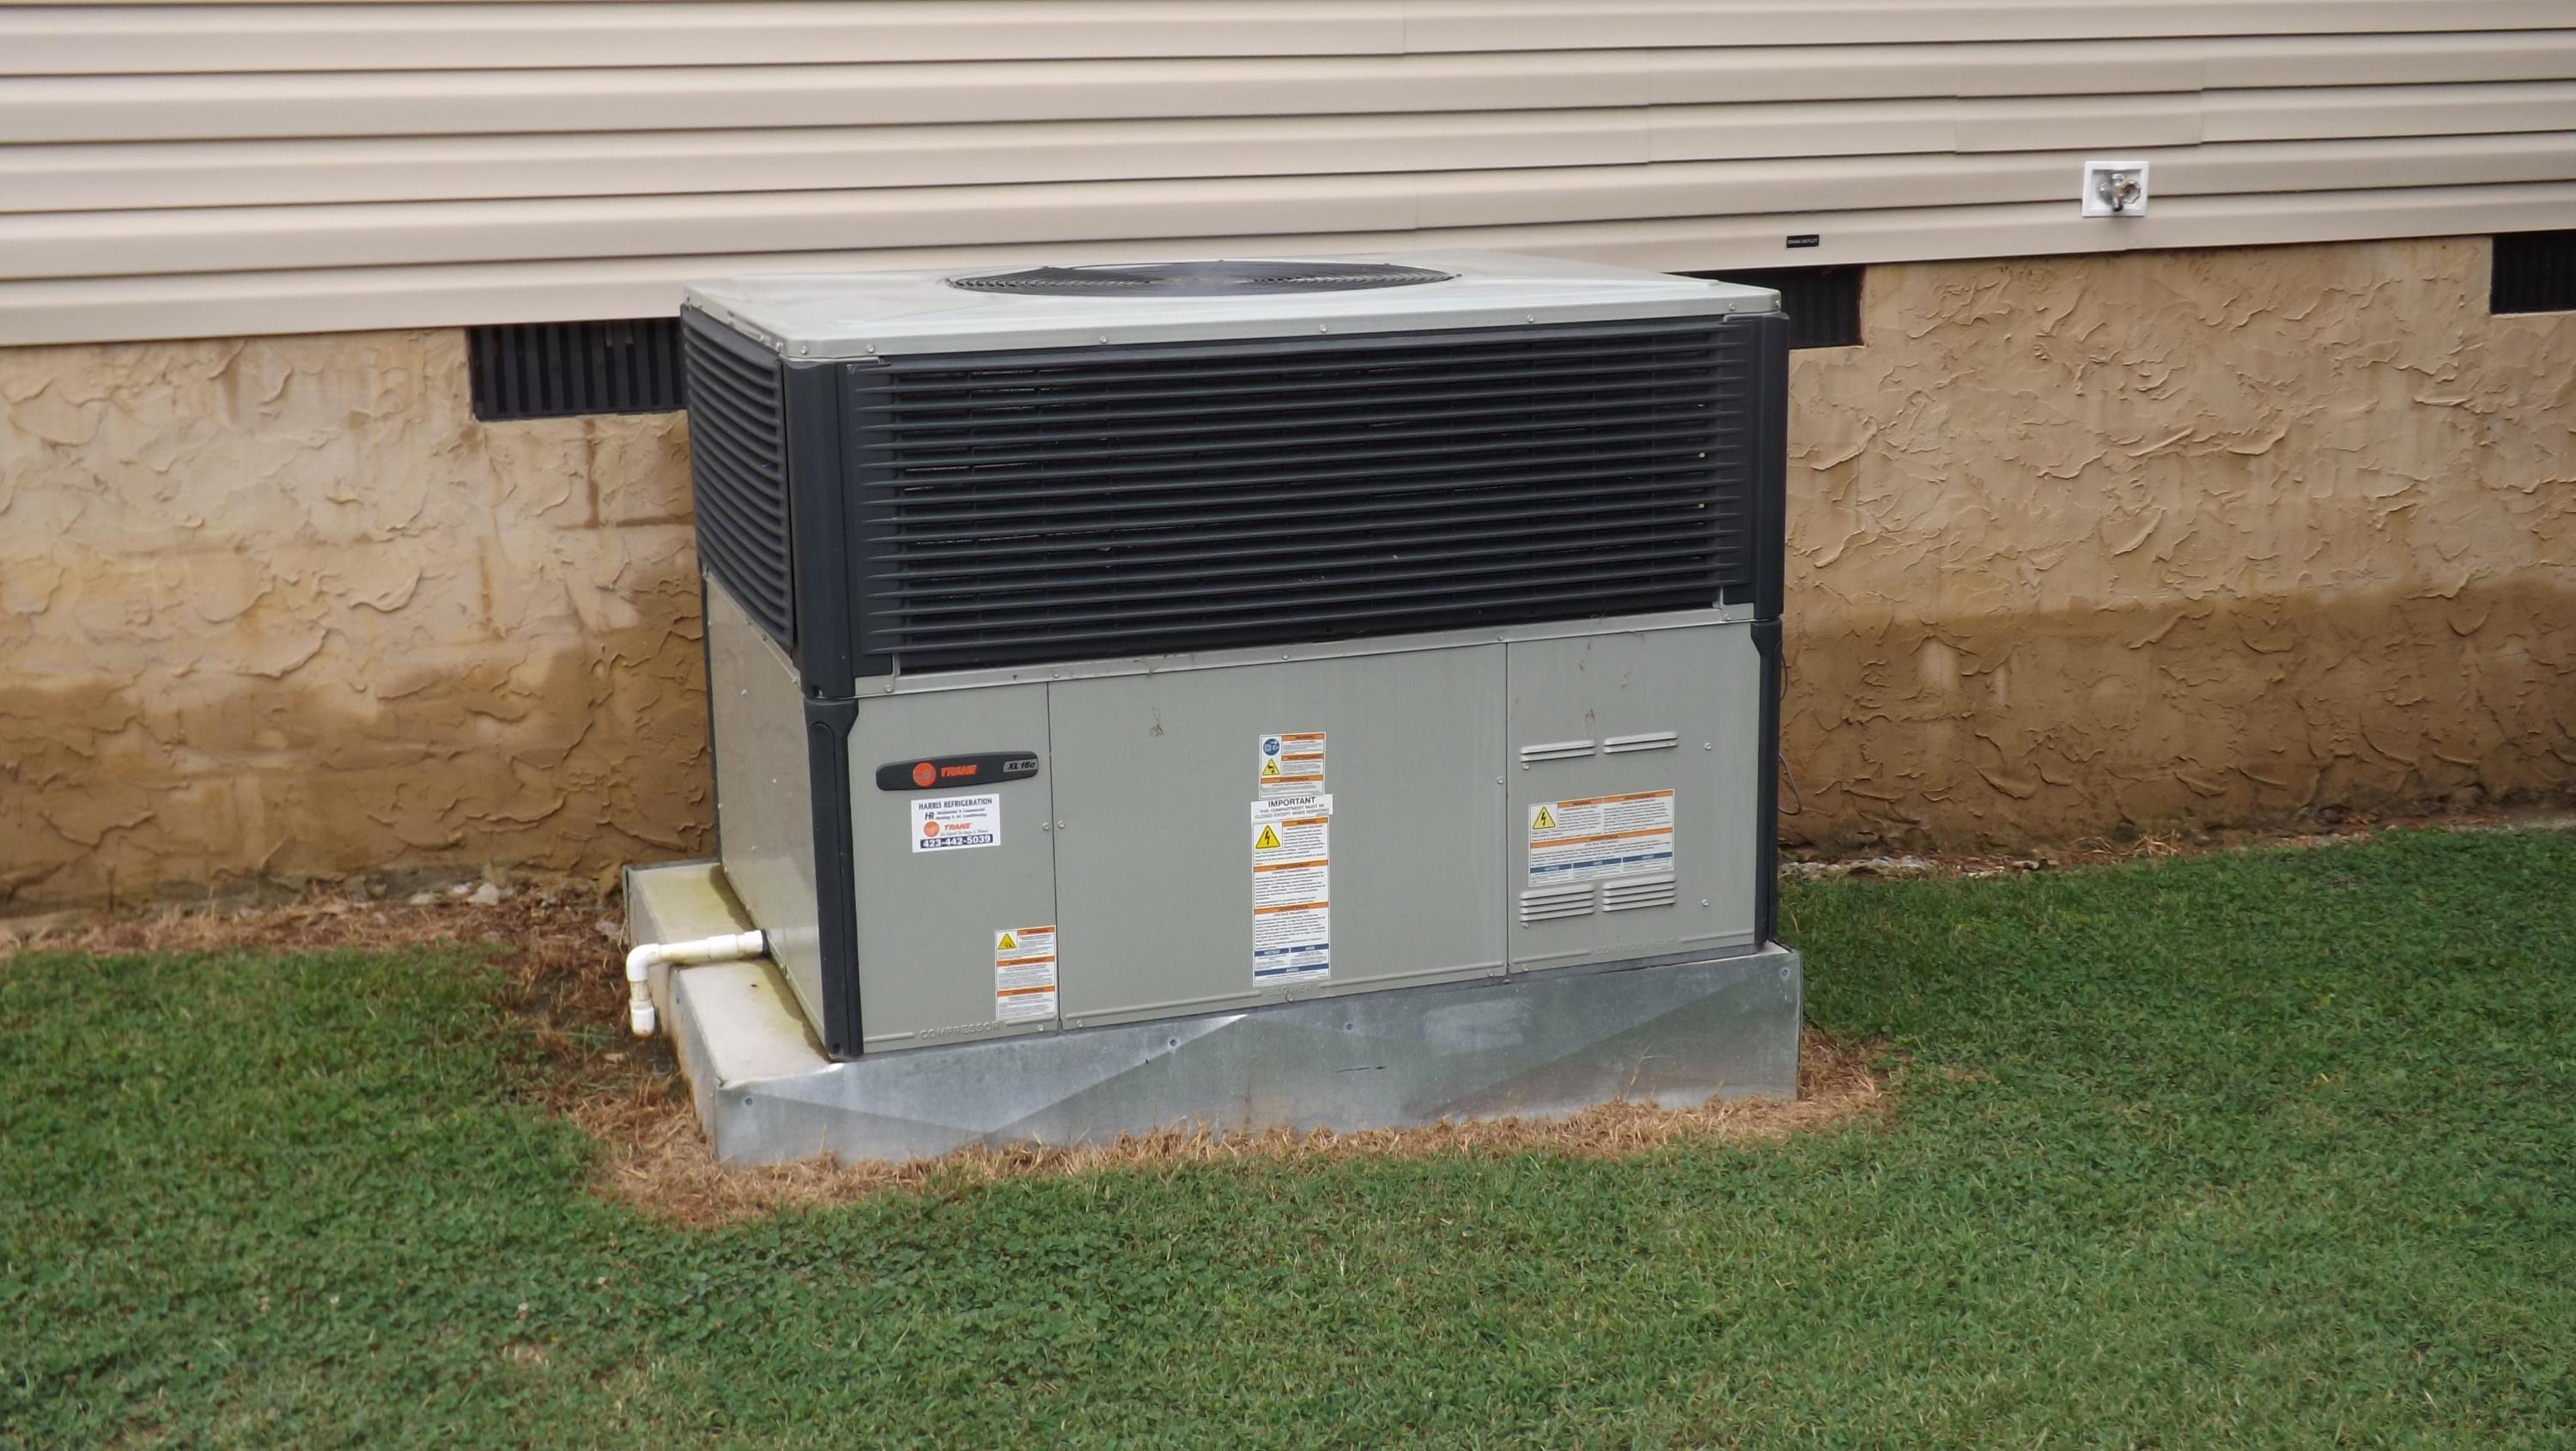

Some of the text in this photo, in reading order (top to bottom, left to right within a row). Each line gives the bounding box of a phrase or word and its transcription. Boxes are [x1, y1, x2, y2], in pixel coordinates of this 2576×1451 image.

[940, 764, 977, 777] TRANE
[919, 798, 993, 810] HARRIS REFRIGERATION
[1268, 797, 1315, 807] IMPORTANT
[945, 823, 973, 831] TRANE
[923, 835, 991, 847] 423-442-5039
[920, 1021, 999, 1039] COMPRESSOR
